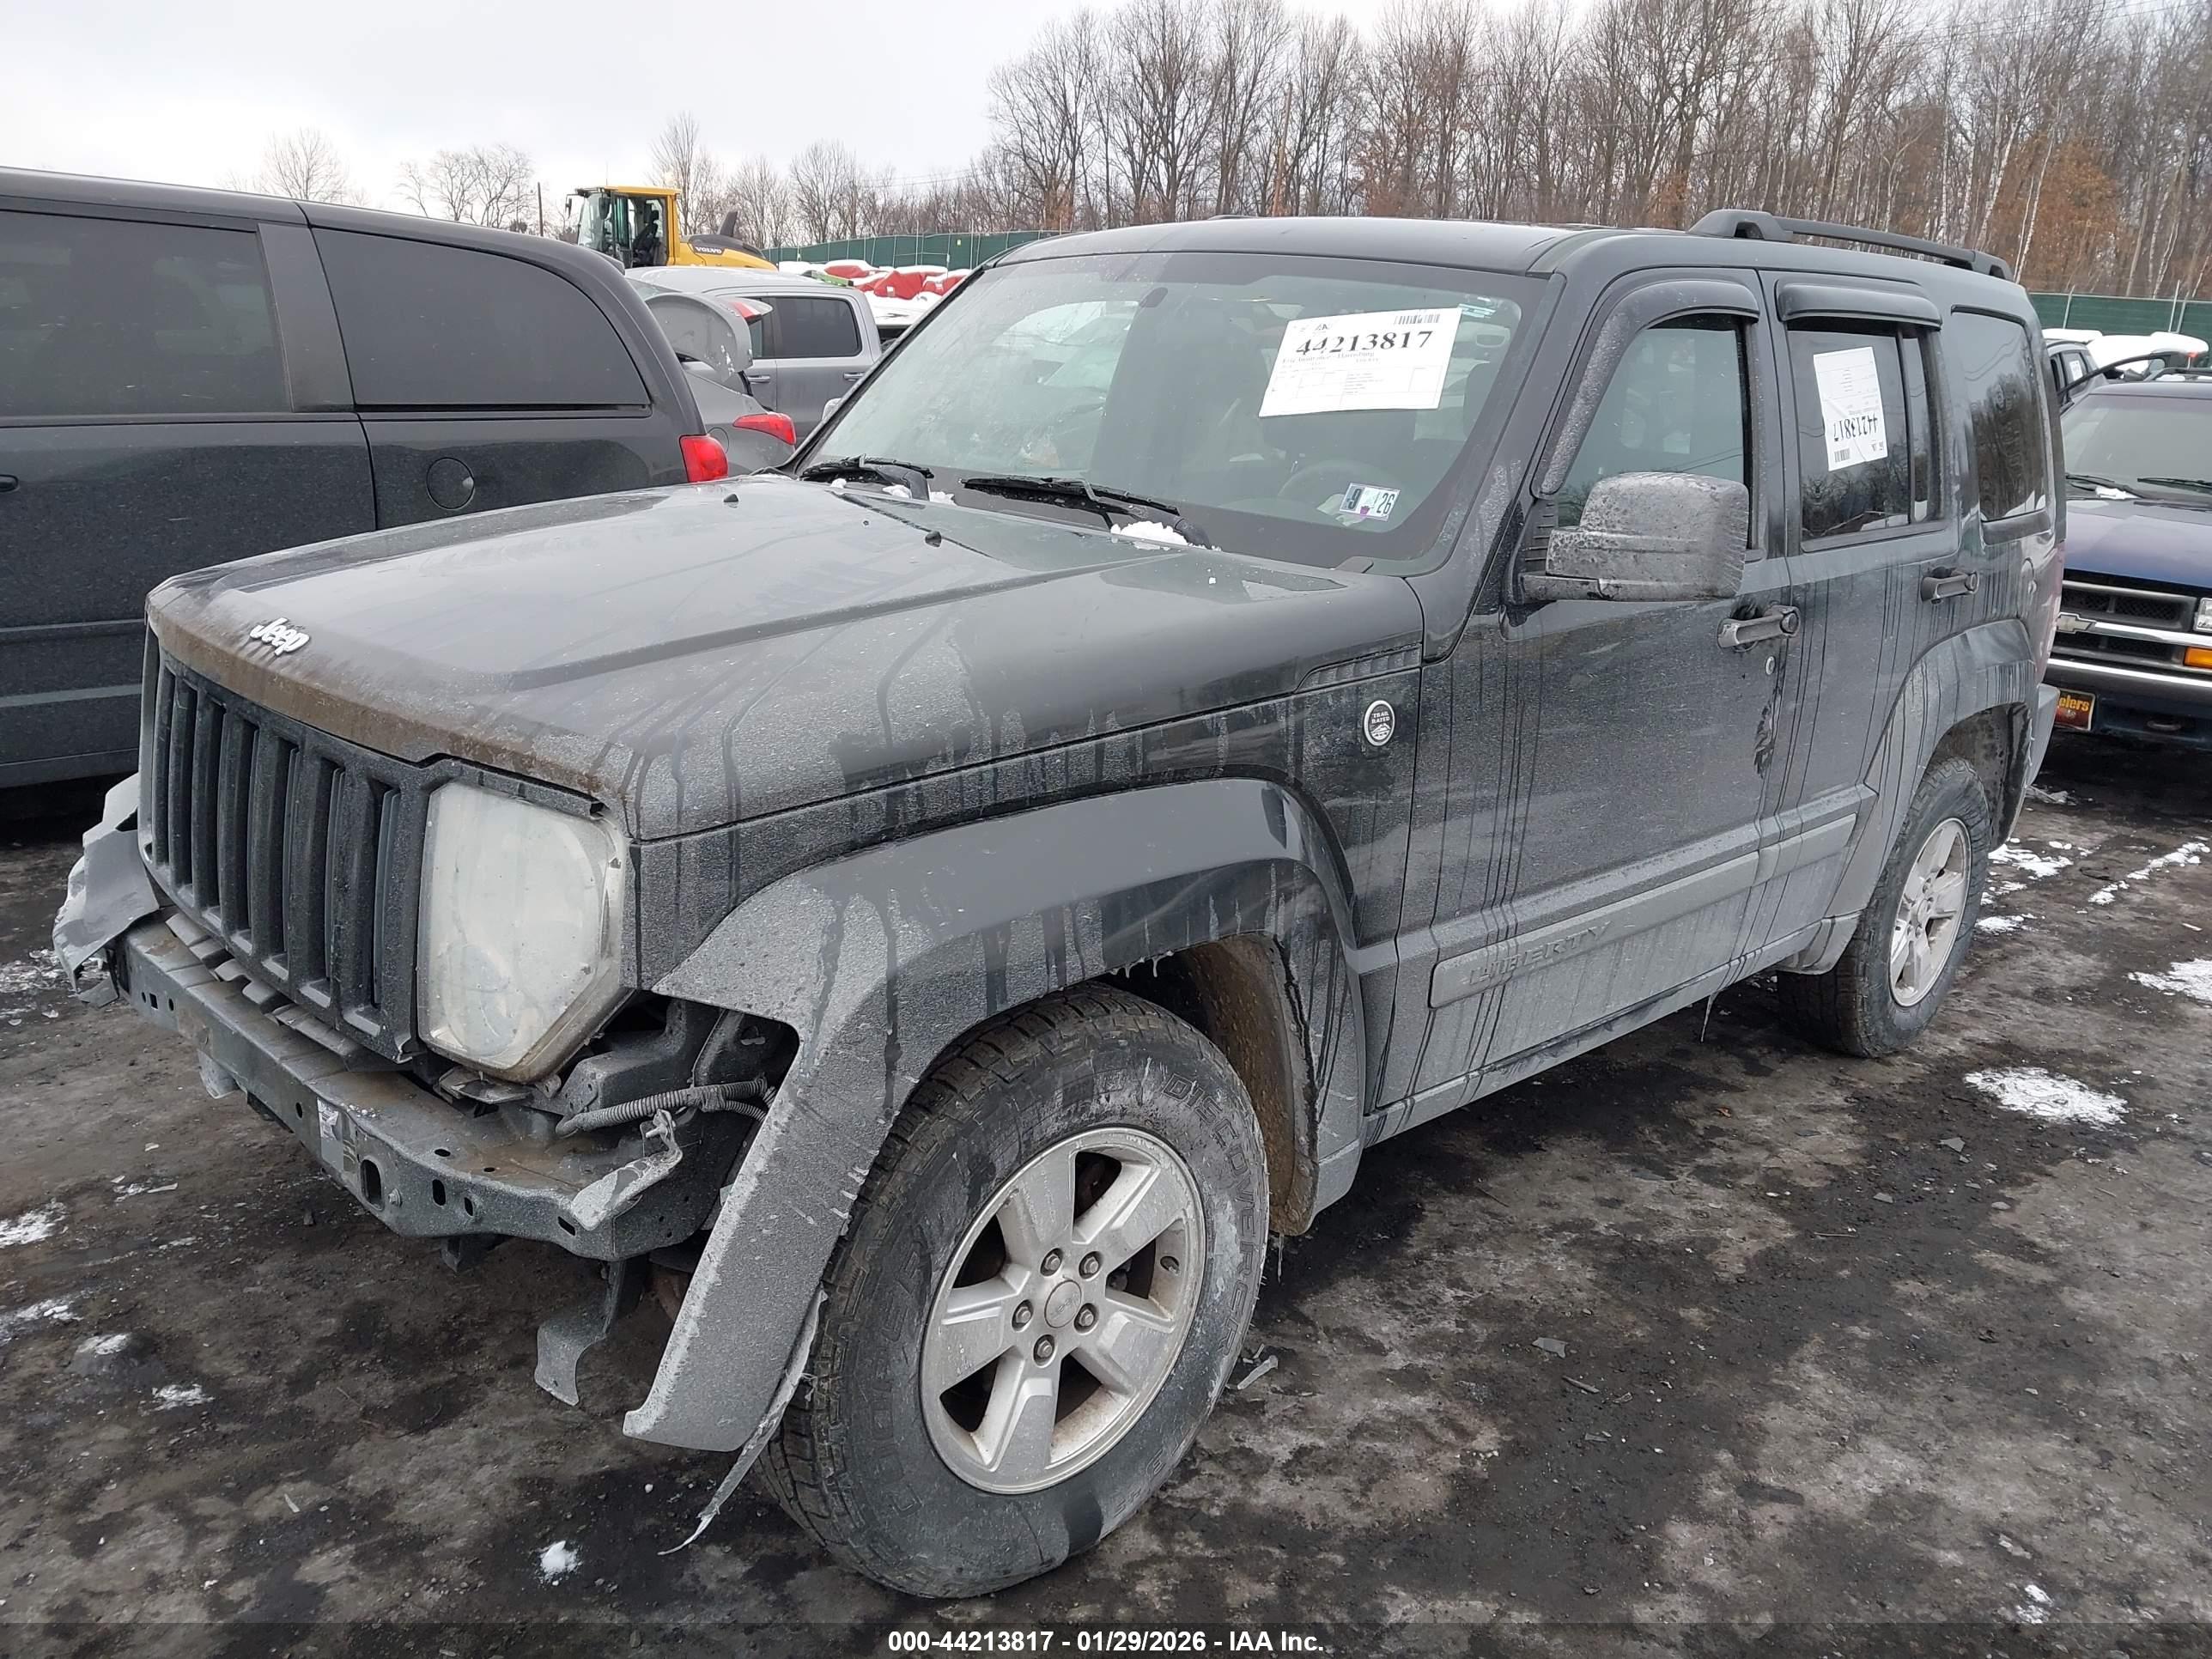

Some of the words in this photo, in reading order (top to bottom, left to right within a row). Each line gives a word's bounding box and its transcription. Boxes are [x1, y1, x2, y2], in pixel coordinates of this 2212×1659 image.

[1296, 331, 1433, 356] 44213817
[1376, 493, 1395, 514] 26
[249, 617, 310, 656] Jeep
[2059, 695, 2090, 712] elers
[1469, 921, 1612, 985] LIBERTY
[1161, 1073, 1257, 1358] DISCOVERER
